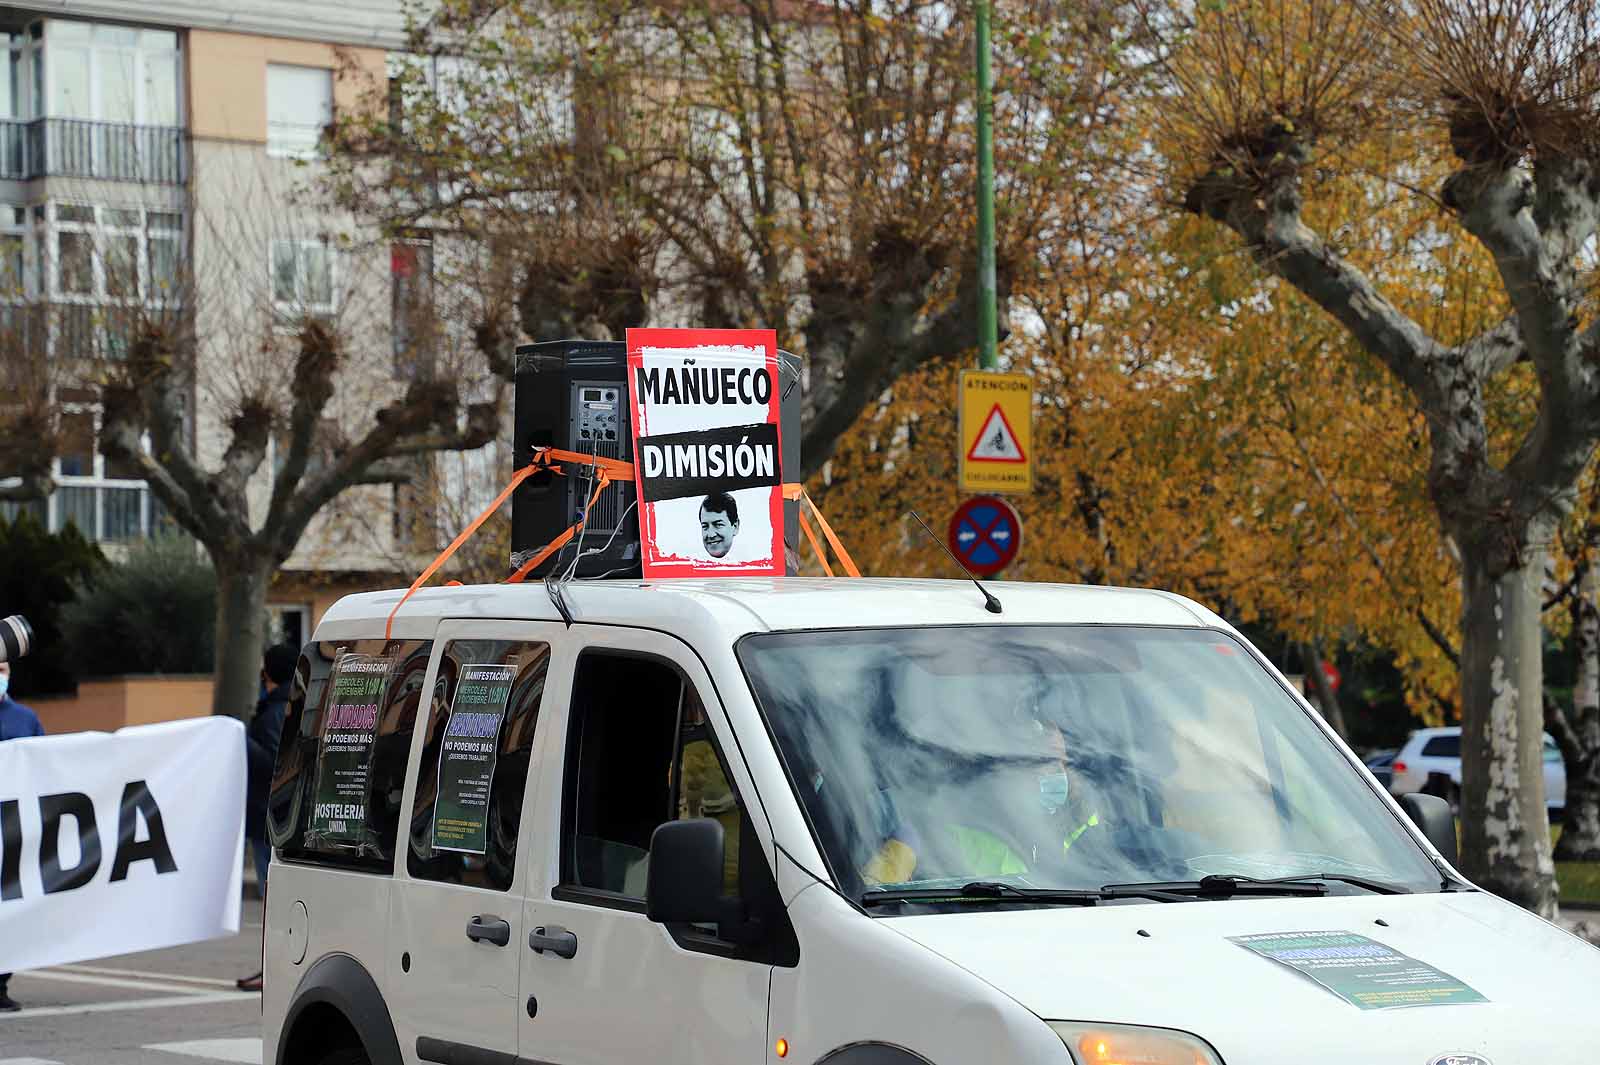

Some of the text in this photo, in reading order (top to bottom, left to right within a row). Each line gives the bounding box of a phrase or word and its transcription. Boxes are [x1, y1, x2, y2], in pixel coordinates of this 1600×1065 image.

[638, 358, 772, 405] MAÑUECO
[643, 435, 775, 478] DIMISIÓN
[445, 741, 493, 752] NO PODEMOS MÁS
[315, 803, 365, 820] HOSTELERIA
[328, 820, 347, 832] UNIDA
[0, 779, 178, 901] IDA
